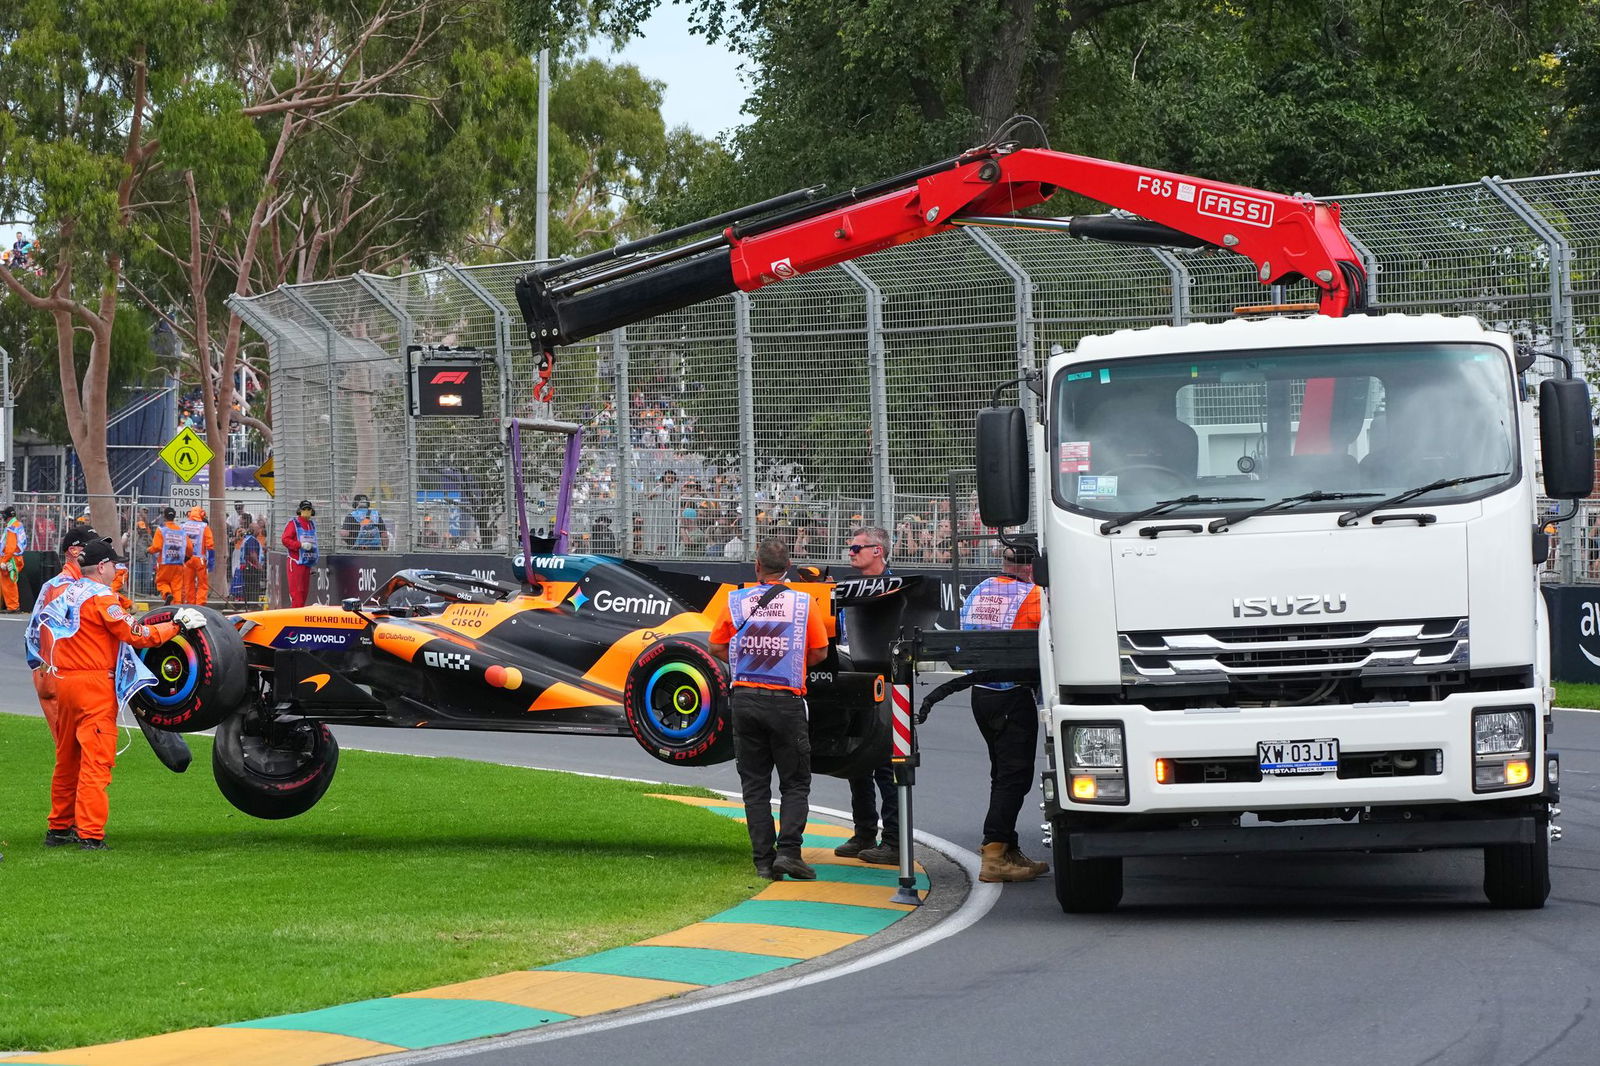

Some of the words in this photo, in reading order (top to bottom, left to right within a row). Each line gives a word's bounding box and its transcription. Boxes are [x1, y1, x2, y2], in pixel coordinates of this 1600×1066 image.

[1137, 175, 1172, 198] F85
[1204, 194, 1268, 222] FASSI
[172, 487, 200, 497] GROSS
[174, 499, 198, 508] LOAD
[358, 568, 377, 592] aws
[835, 577, 903, 600] ETIHAD
[593, 590, 672, 616] Gemini
[1233, 593, 1347, 618] ISUZU
[304, 615, 339, 624] RICHARD
[341, 617, 364, 625] MILLE
[299, 633, 313, 643] DP
[313, 635, 346, 644] WORLD
[740, 635, 790, 651] COURSE
[742, 648, 785, 657] ACCESS
[424, 651, 471, 671] OKX
[809, 671, 833, 683] groq
